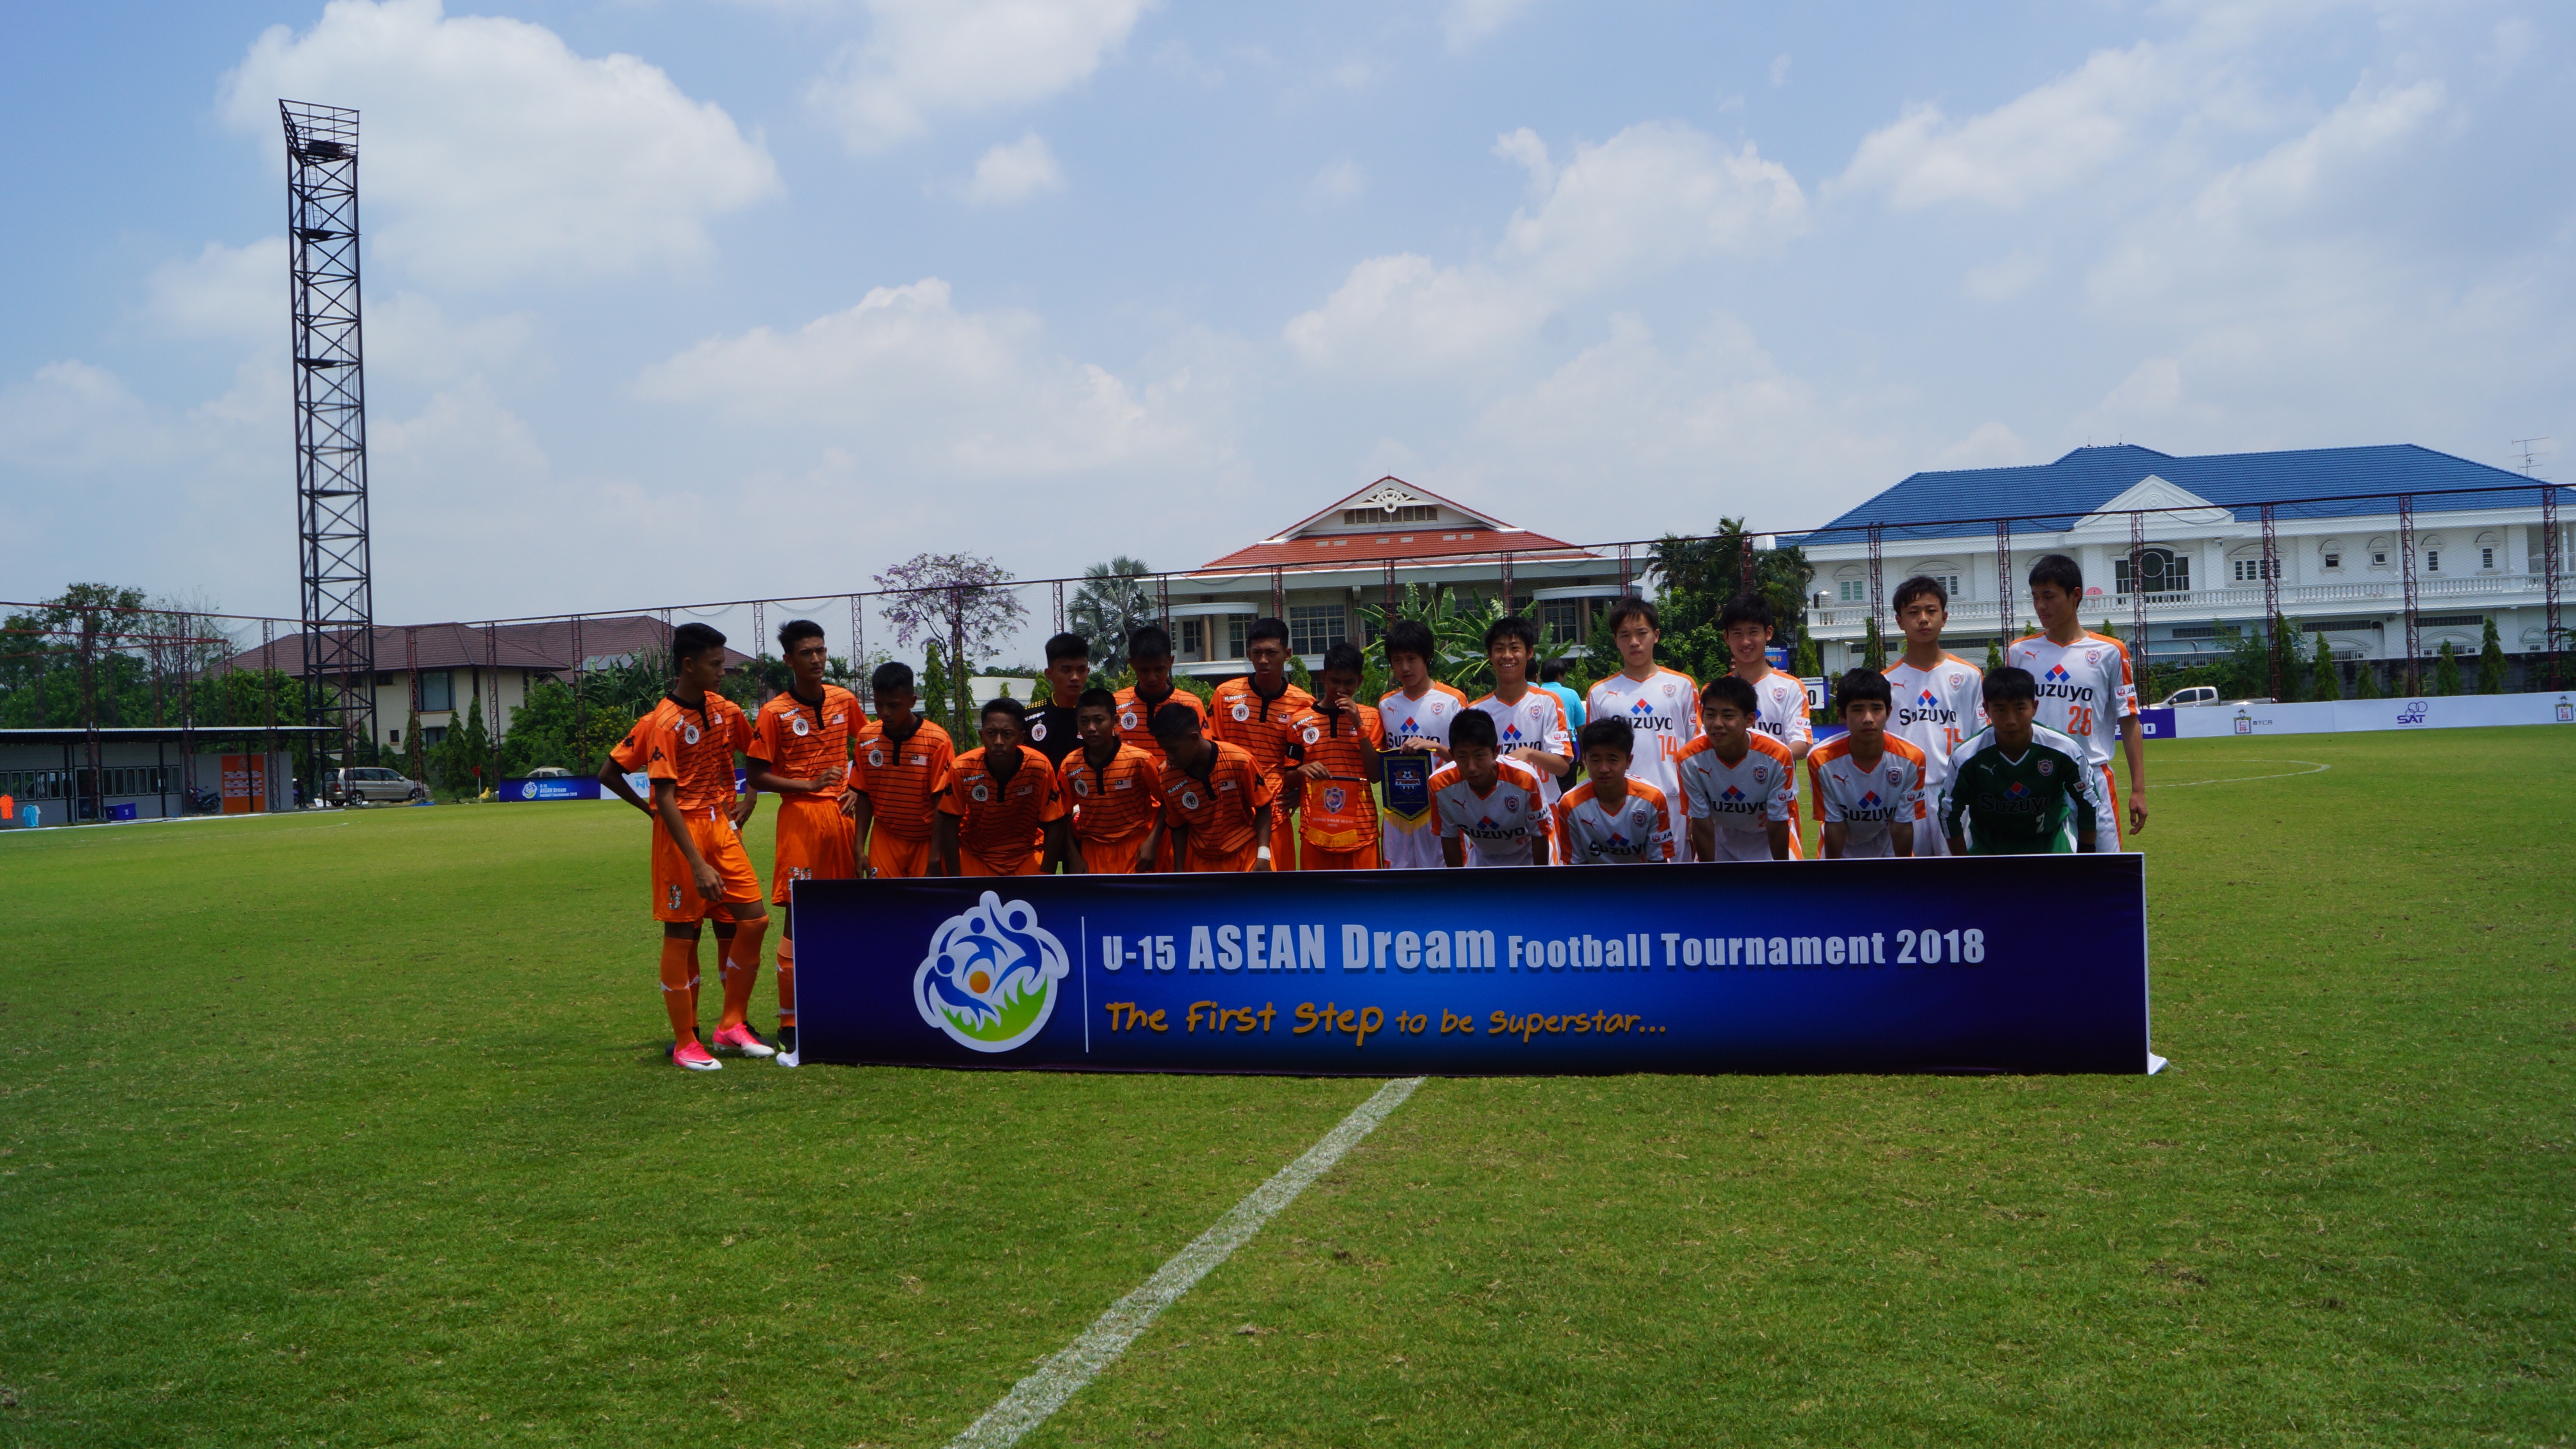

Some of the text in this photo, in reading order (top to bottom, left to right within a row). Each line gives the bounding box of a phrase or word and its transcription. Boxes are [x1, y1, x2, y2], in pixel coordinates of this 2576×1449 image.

[1808, 690, 1816, 706] 0
[2035, 684, 2093, 702] uzuyo
[780, 707, 799, 719] Kappa
[1024, 711, 1045, 721] Kappa
[1899, 708, 1956, 726] Suzuyo
[2067, 705, 2092, 736] 28
[2397, 715, 2425, 724] SAT
[1292, 716, 1313, 729] Kappa
[1658, 735, 1677, 762] 14
[963, 773, 985, 782] Kappa
[1167, 779, 1188, 794] Kappa
[1662, 831, 1673, 840] JA
[1589, 841, 1642, 857] Suzuy
[668, 885, 681, 910] 9
[1103, 925, 1984, 970] U-15 ASEAN Dream Football Tournament 2018
[1106, 1001, 1665, 1046] The First Step to be Superstar...
